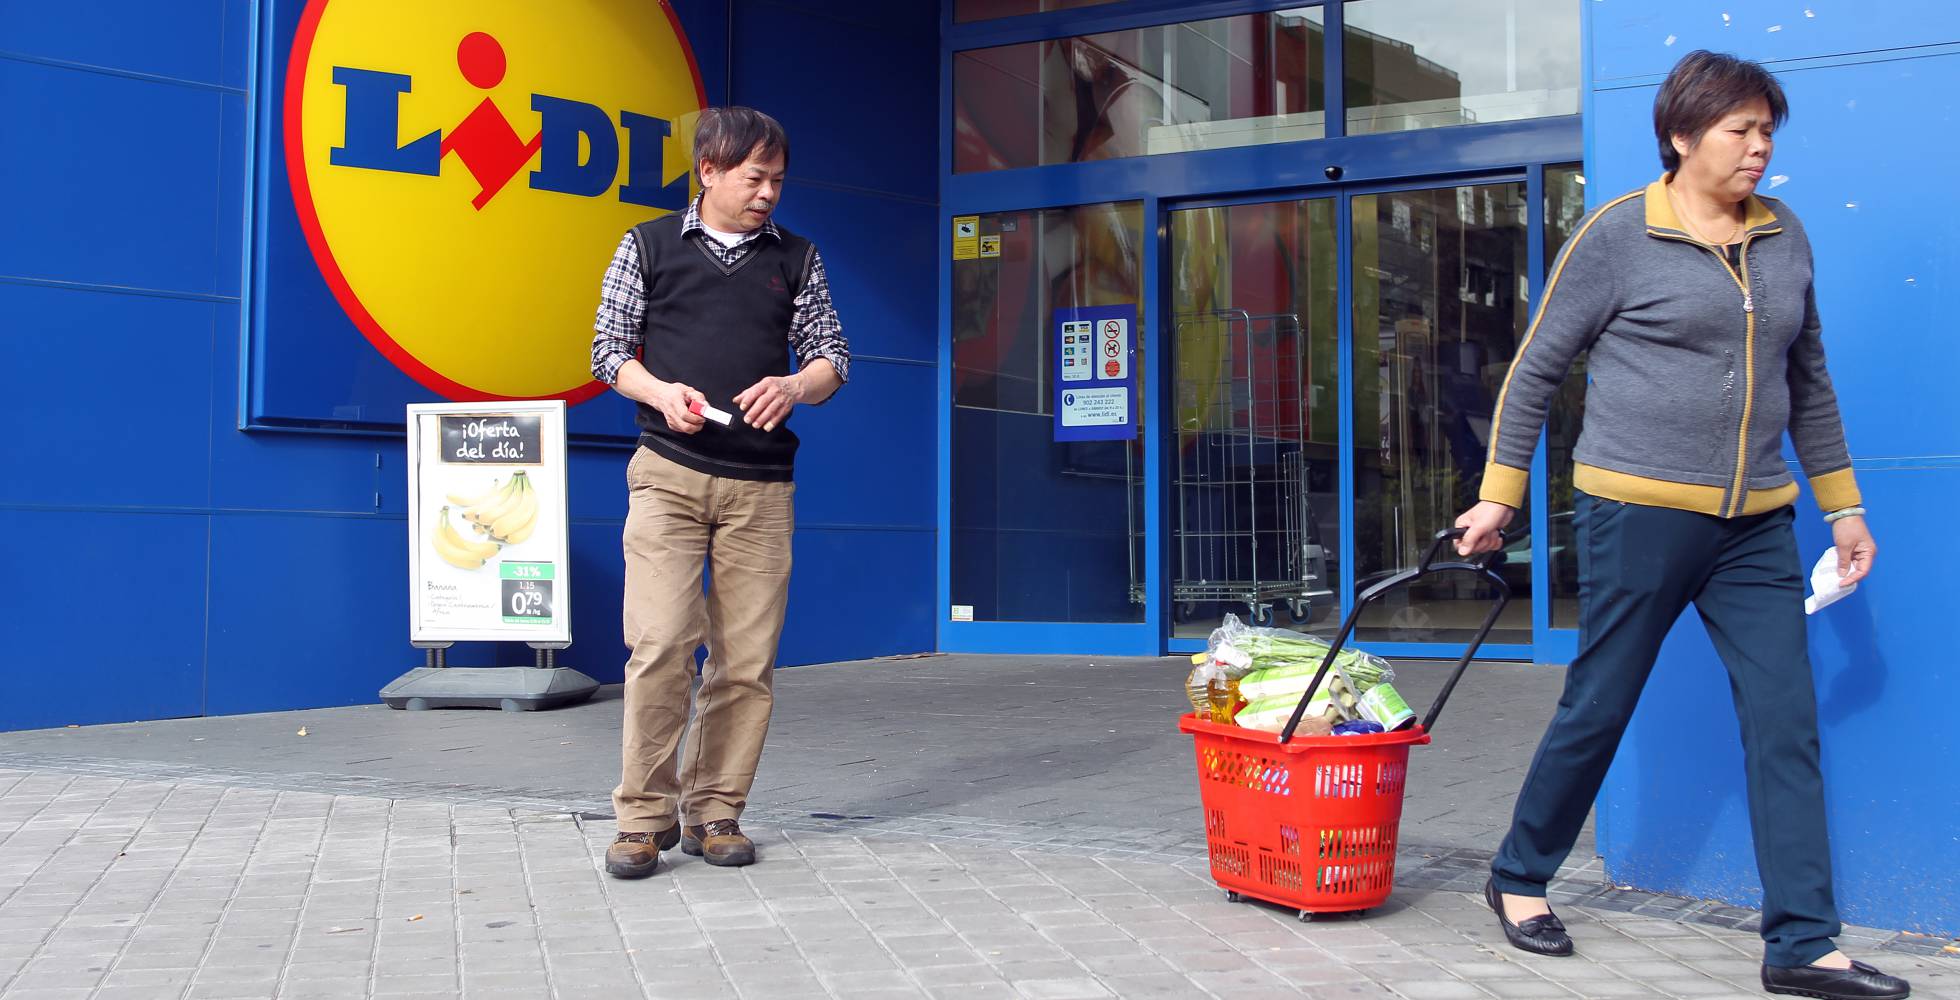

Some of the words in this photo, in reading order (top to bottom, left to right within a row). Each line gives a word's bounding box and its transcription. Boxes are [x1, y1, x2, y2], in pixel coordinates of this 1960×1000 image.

[462, 418, 521, 442] ¡Oferta
[456, 441, 486, 459] del
[492, 441, 524, 459] día!
[513, 566, 542, 578] -31%
